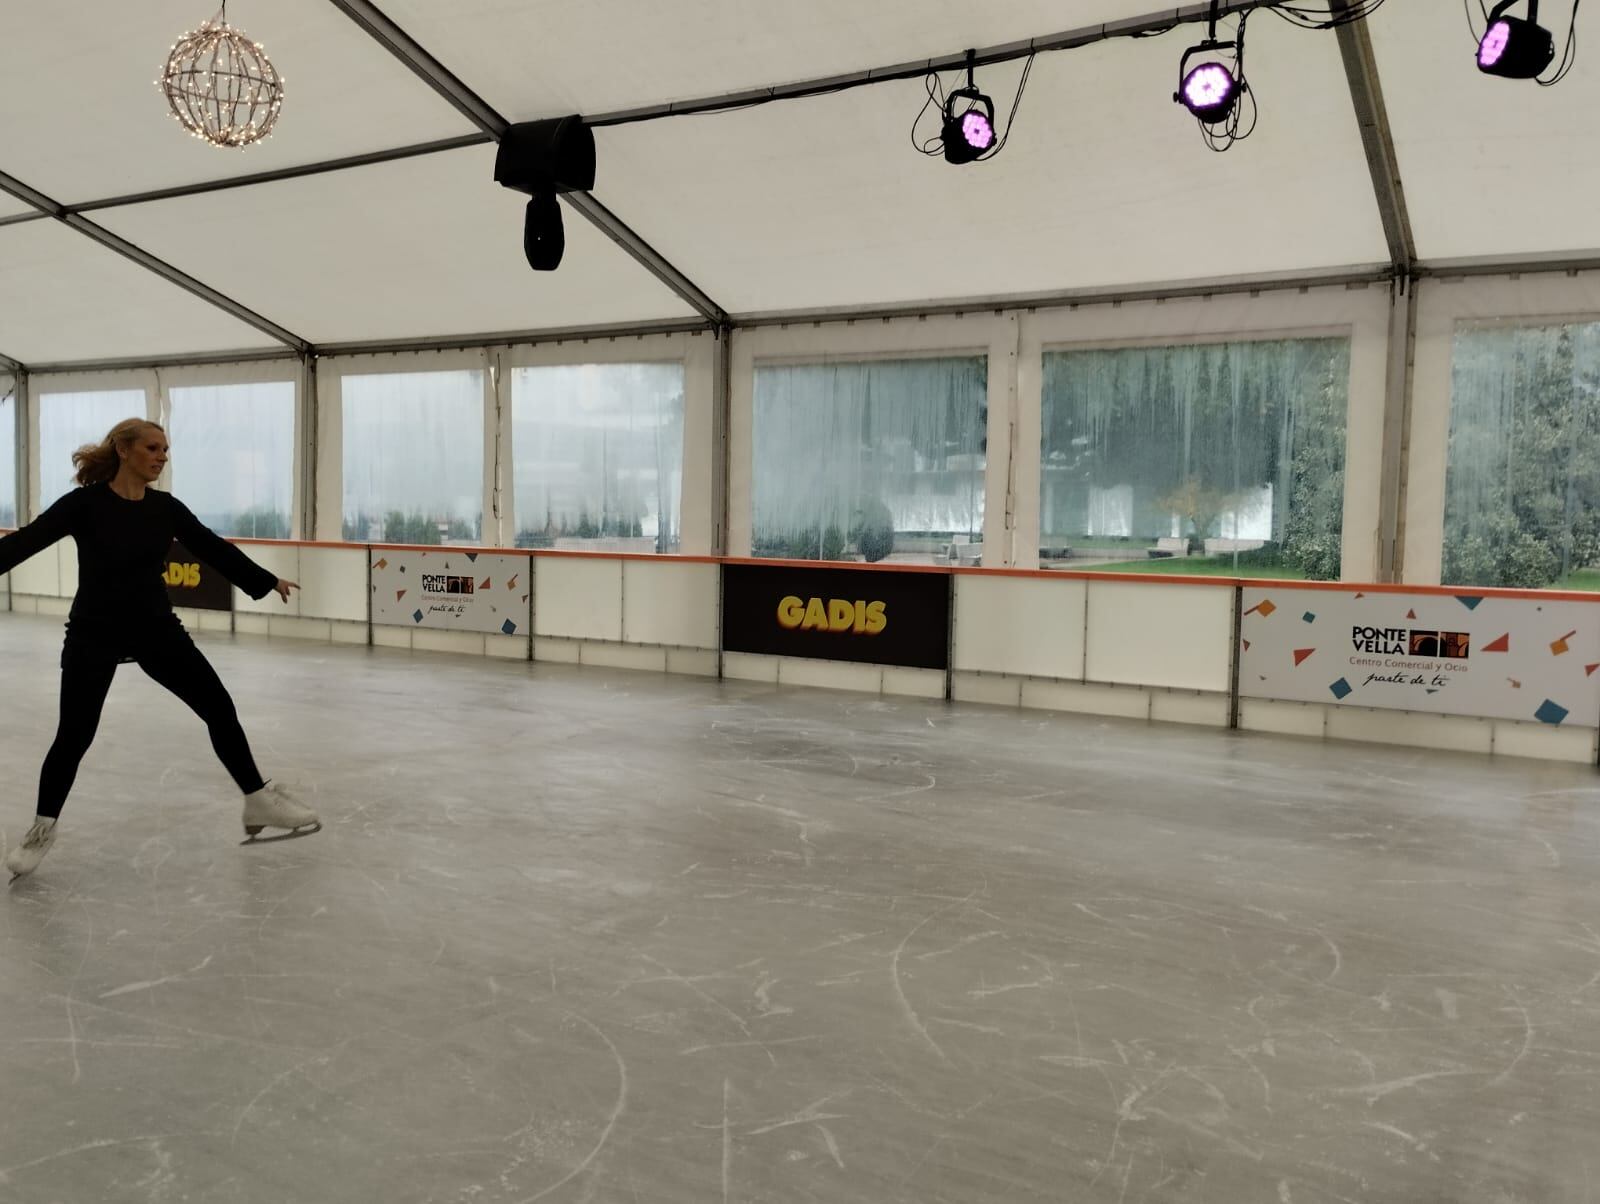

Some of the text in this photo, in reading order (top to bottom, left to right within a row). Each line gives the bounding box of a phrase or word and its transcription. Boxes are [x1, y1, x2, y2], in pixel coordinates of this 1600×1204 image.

[422, 574, 446, 584] PONTE
[422, 583, 446, 593] VELLA
[777, 595, 887, 635] GADIS
[1352, 626, 1407, 641] PONTE
[1352, 640, 1405, 655] VELLA
[1349, 656, 1468, 672] Centro Comercial y Ocio
[1362, 672, 1409, 687] parte
[1410, 674, 1426, 685] de
